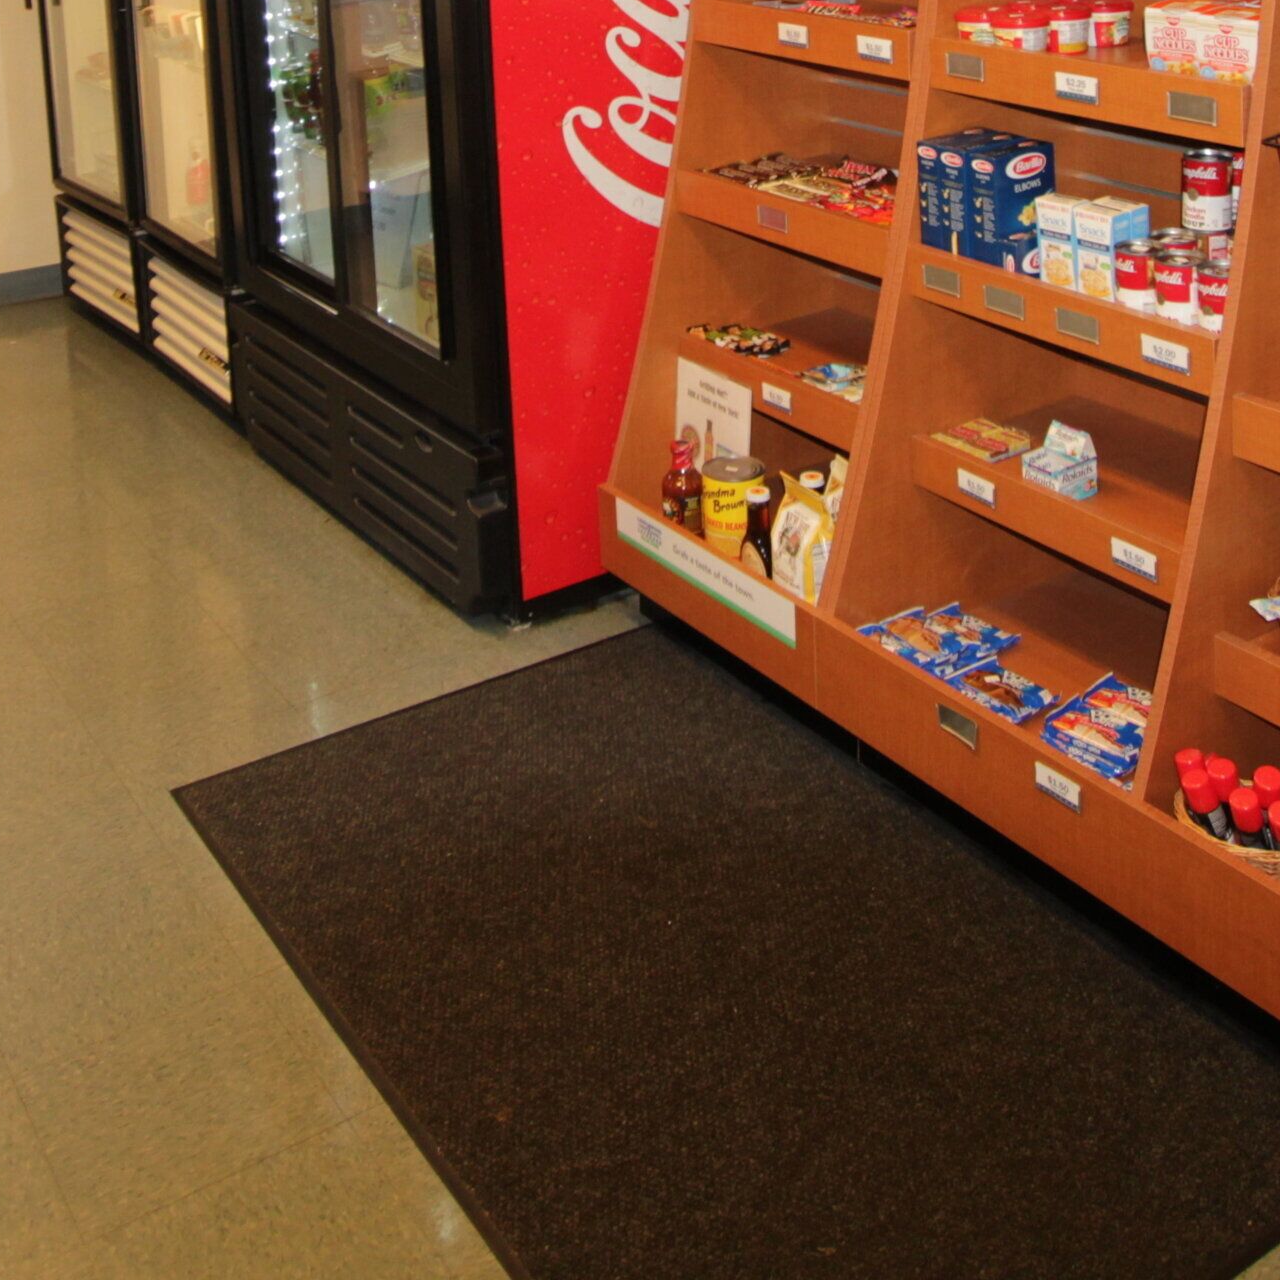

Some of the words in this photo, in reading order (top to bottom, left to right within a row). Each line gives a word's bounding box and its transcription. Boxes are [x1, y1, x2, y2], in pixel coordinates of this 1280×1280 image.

[1014, 178, 1042, 194] ELBOWS
[1153, 344, 1177, 360] $2.00
[1061, 463, 1094, 484] Rolaids
[703, 488, 736, 500] randma
[696, 558, 713, 574] taste
[722, 573, 734, 589] the
